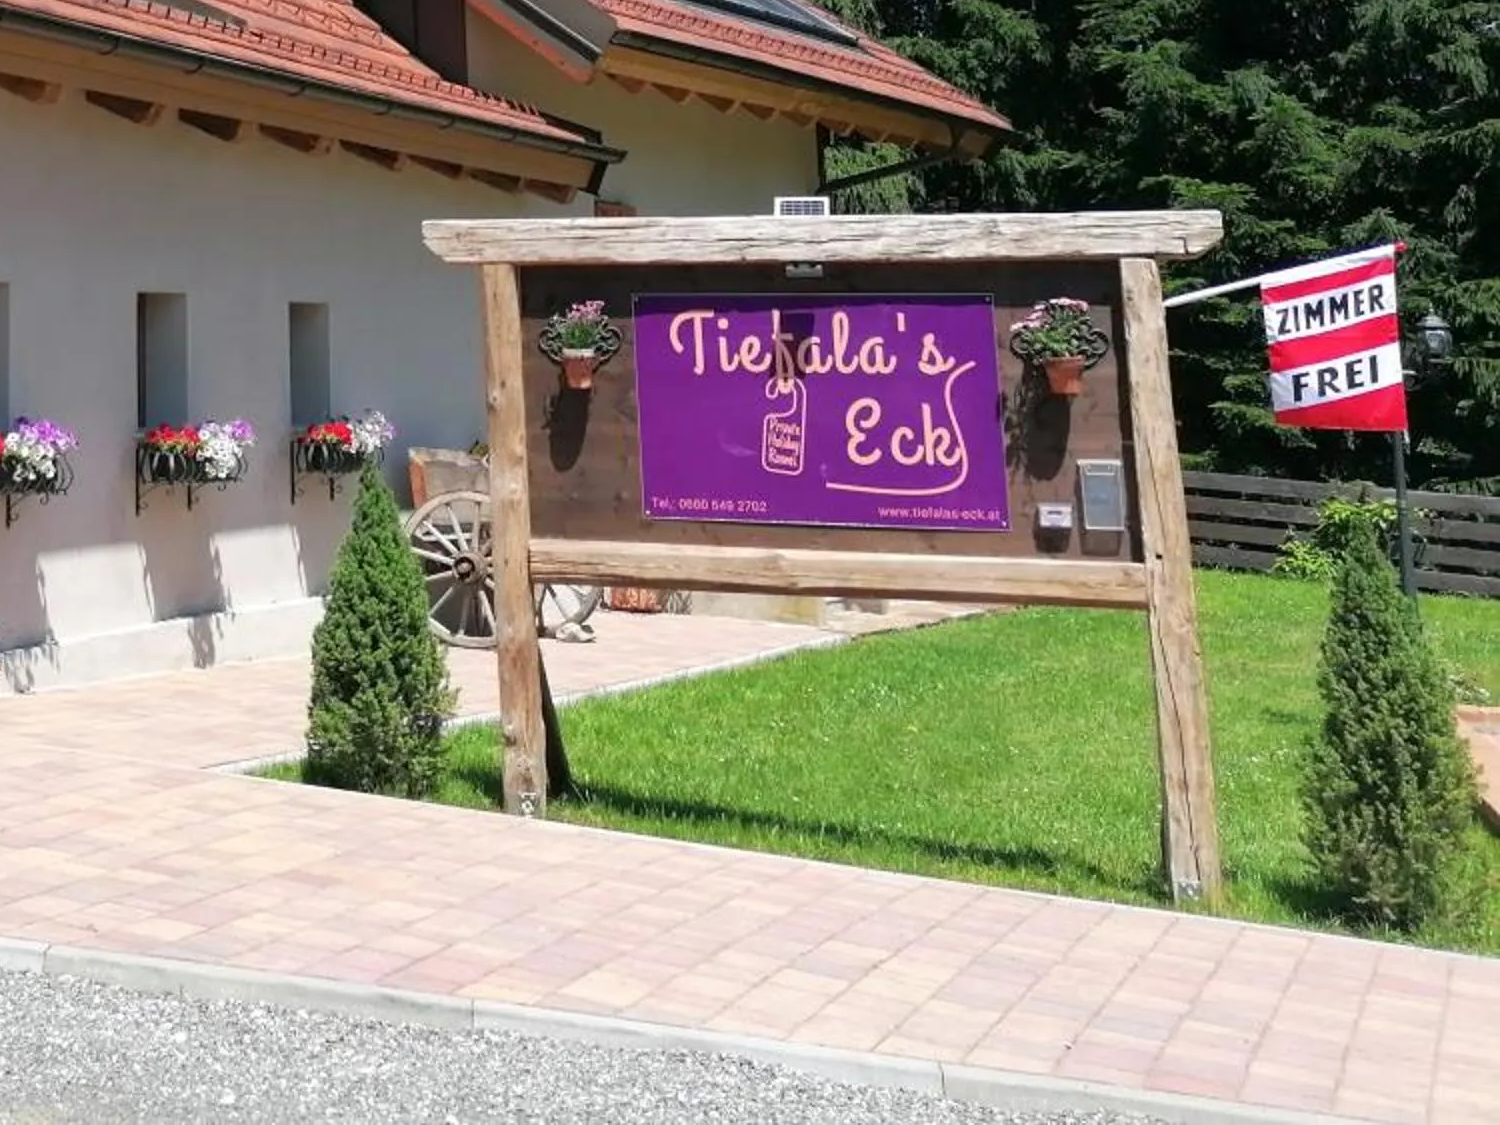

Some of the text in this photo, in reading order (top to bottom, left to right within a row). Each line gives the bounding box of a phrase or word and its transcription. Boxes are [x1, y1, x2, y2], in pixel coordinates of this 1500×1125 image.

[1275, 284, 1385, 336] ZIMMER
[1291, 354, 1380, 403] FREI
[844, 397, 963, 467] Eck
